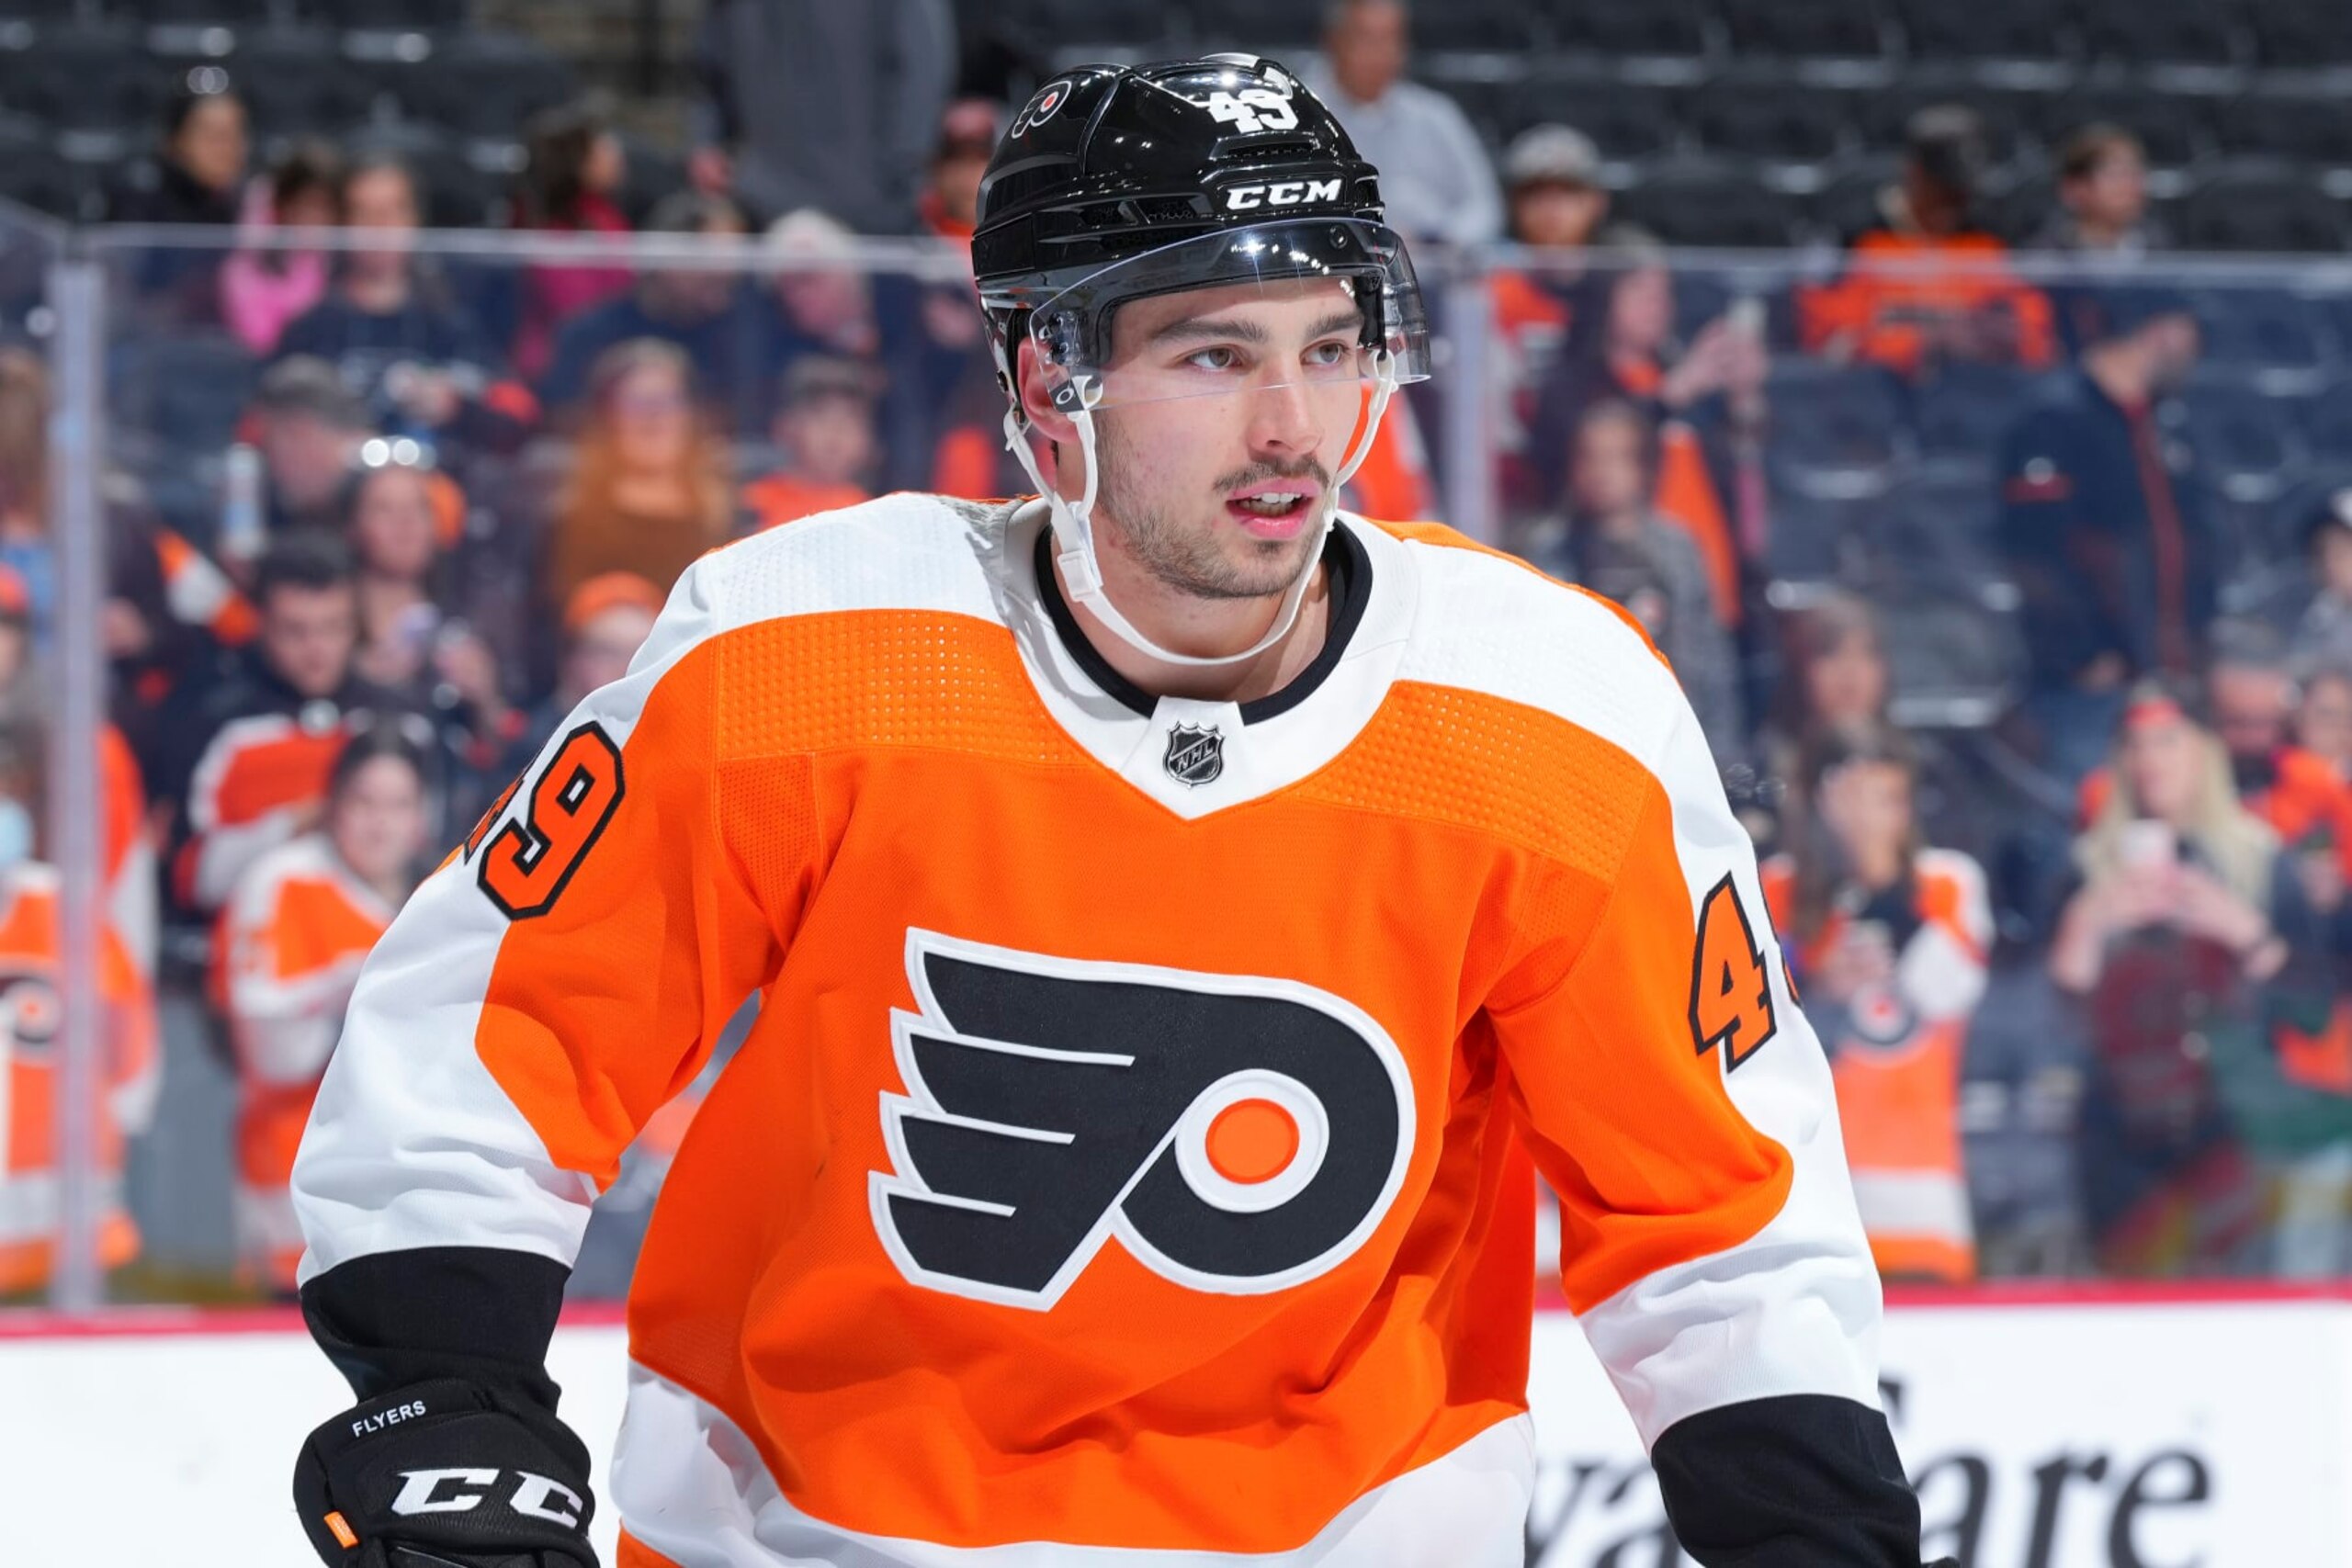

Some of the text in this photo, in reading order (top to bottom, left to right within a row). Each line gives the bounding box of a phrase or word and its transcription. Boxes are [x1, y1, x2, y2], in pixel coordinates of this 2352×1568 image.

[1209, 89, 1299, 133] 49
[1227, 179, 1341, 210] CCM
[1176, 742, 1214, 773] NHL
[464, 720, 626, 921] 9
[1688, 871, 1804, 1073] 4
[352, 1401, 426, 1438] FLYERS
